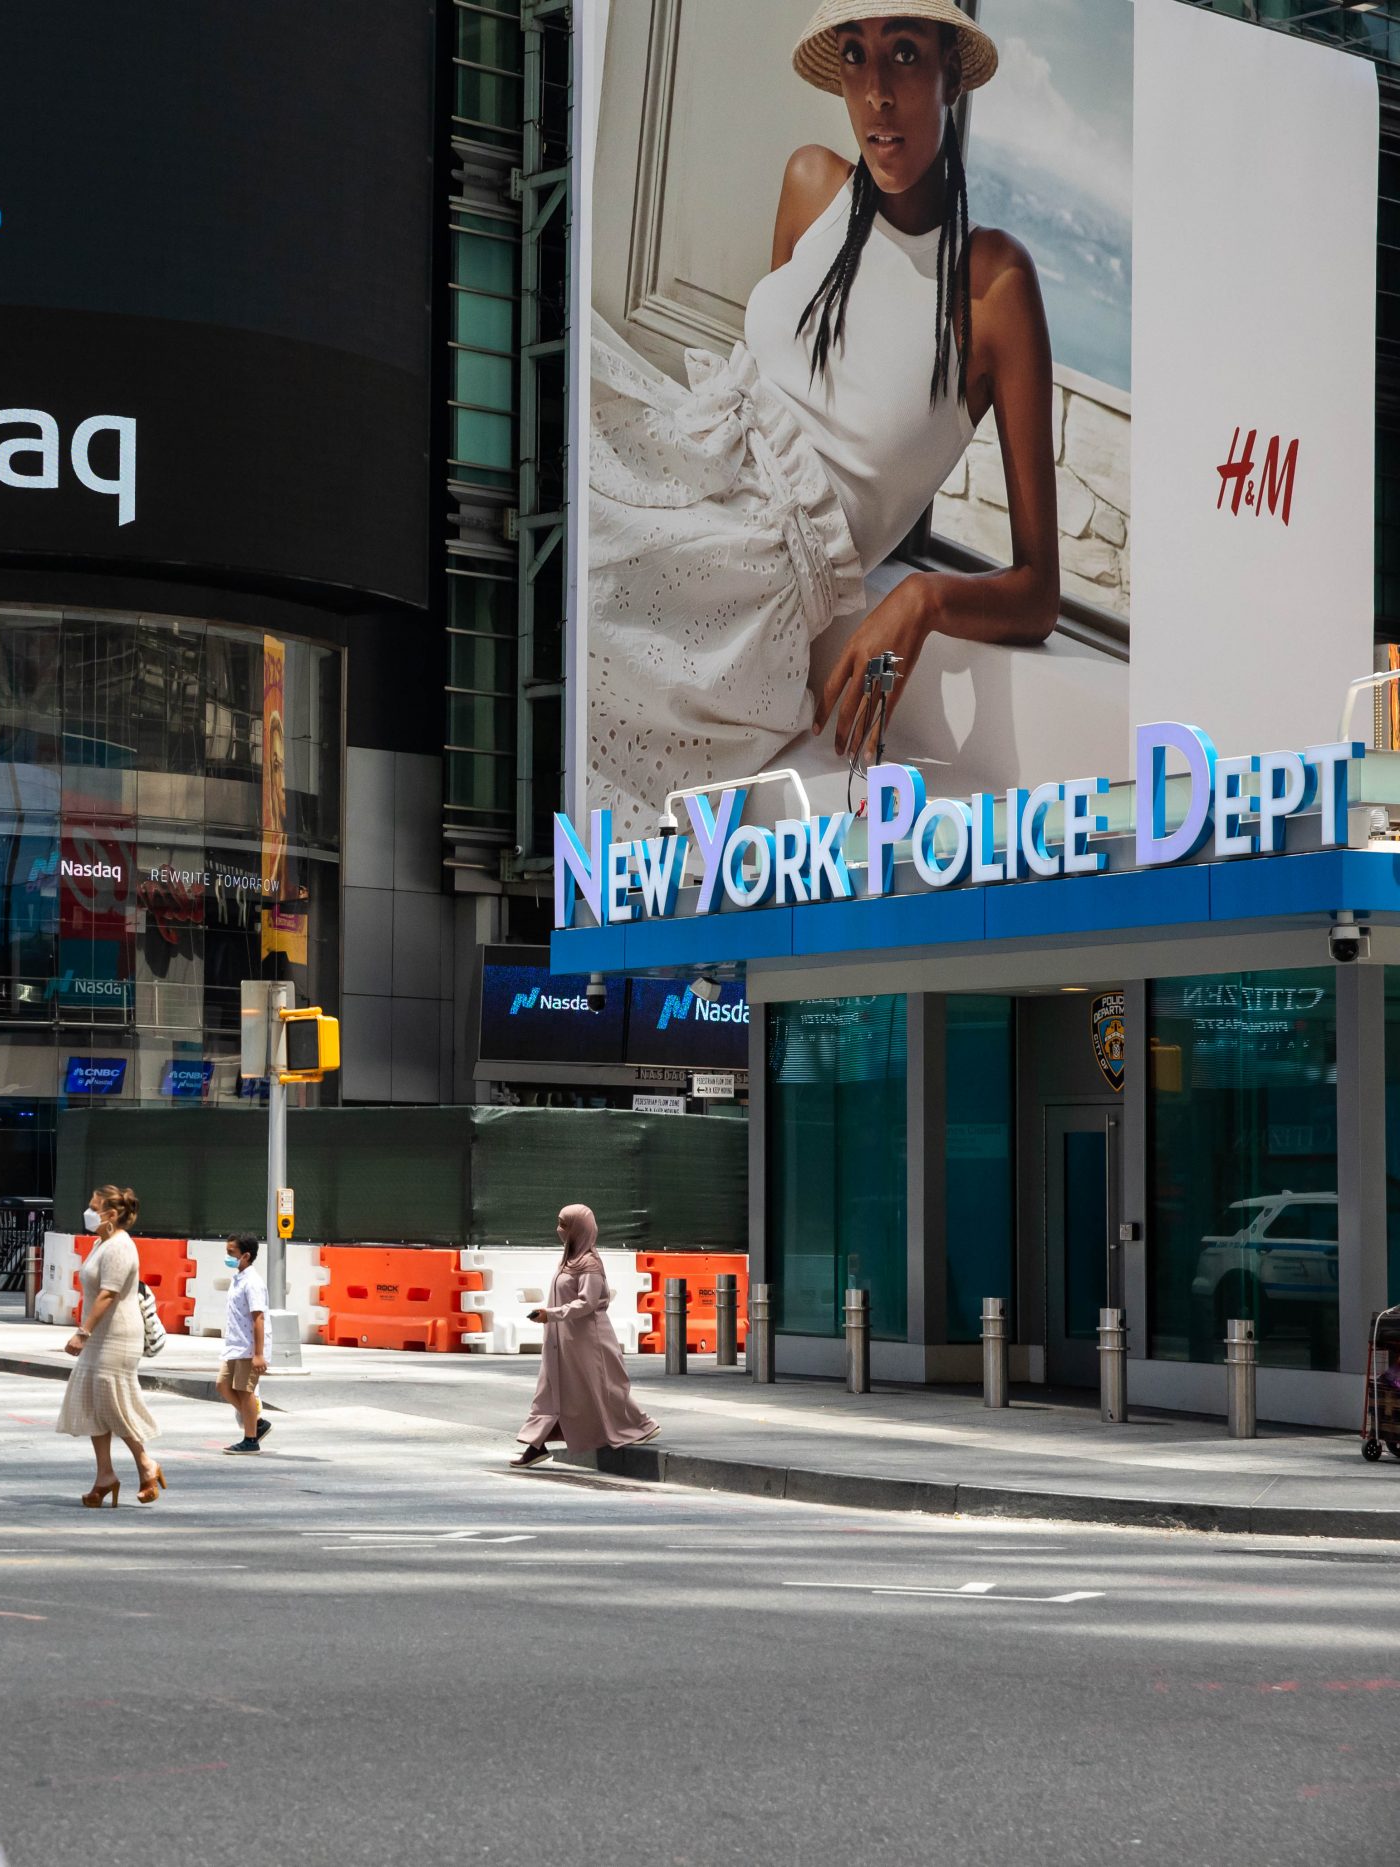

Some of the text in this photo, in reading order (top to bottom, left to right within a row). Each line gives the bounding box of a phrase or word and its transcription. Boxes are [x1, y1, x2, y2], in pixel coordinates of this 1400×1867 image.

[1216, 426, 1299, 527] H&M
[554, 721, 1366, 929] NEW YORK POLICE DEPT
[61, 860, 281, 892] Nasdaq REWRITE TOMORROW
[540, 995, 599, 1014] Nasda
[695, 998, 749, 1024] Nasda
[1102, 995, 1124, 1008] POLIC
[1093, 1005, 1125, 1024] DEPARTM
[1093, 1033, 1103, 1056] CITY
[85, 1068, 120, 1077] CNBC
[177, 1071, 209, 1080] CNBC
[376, 1284, 398, 1292] ROCK
